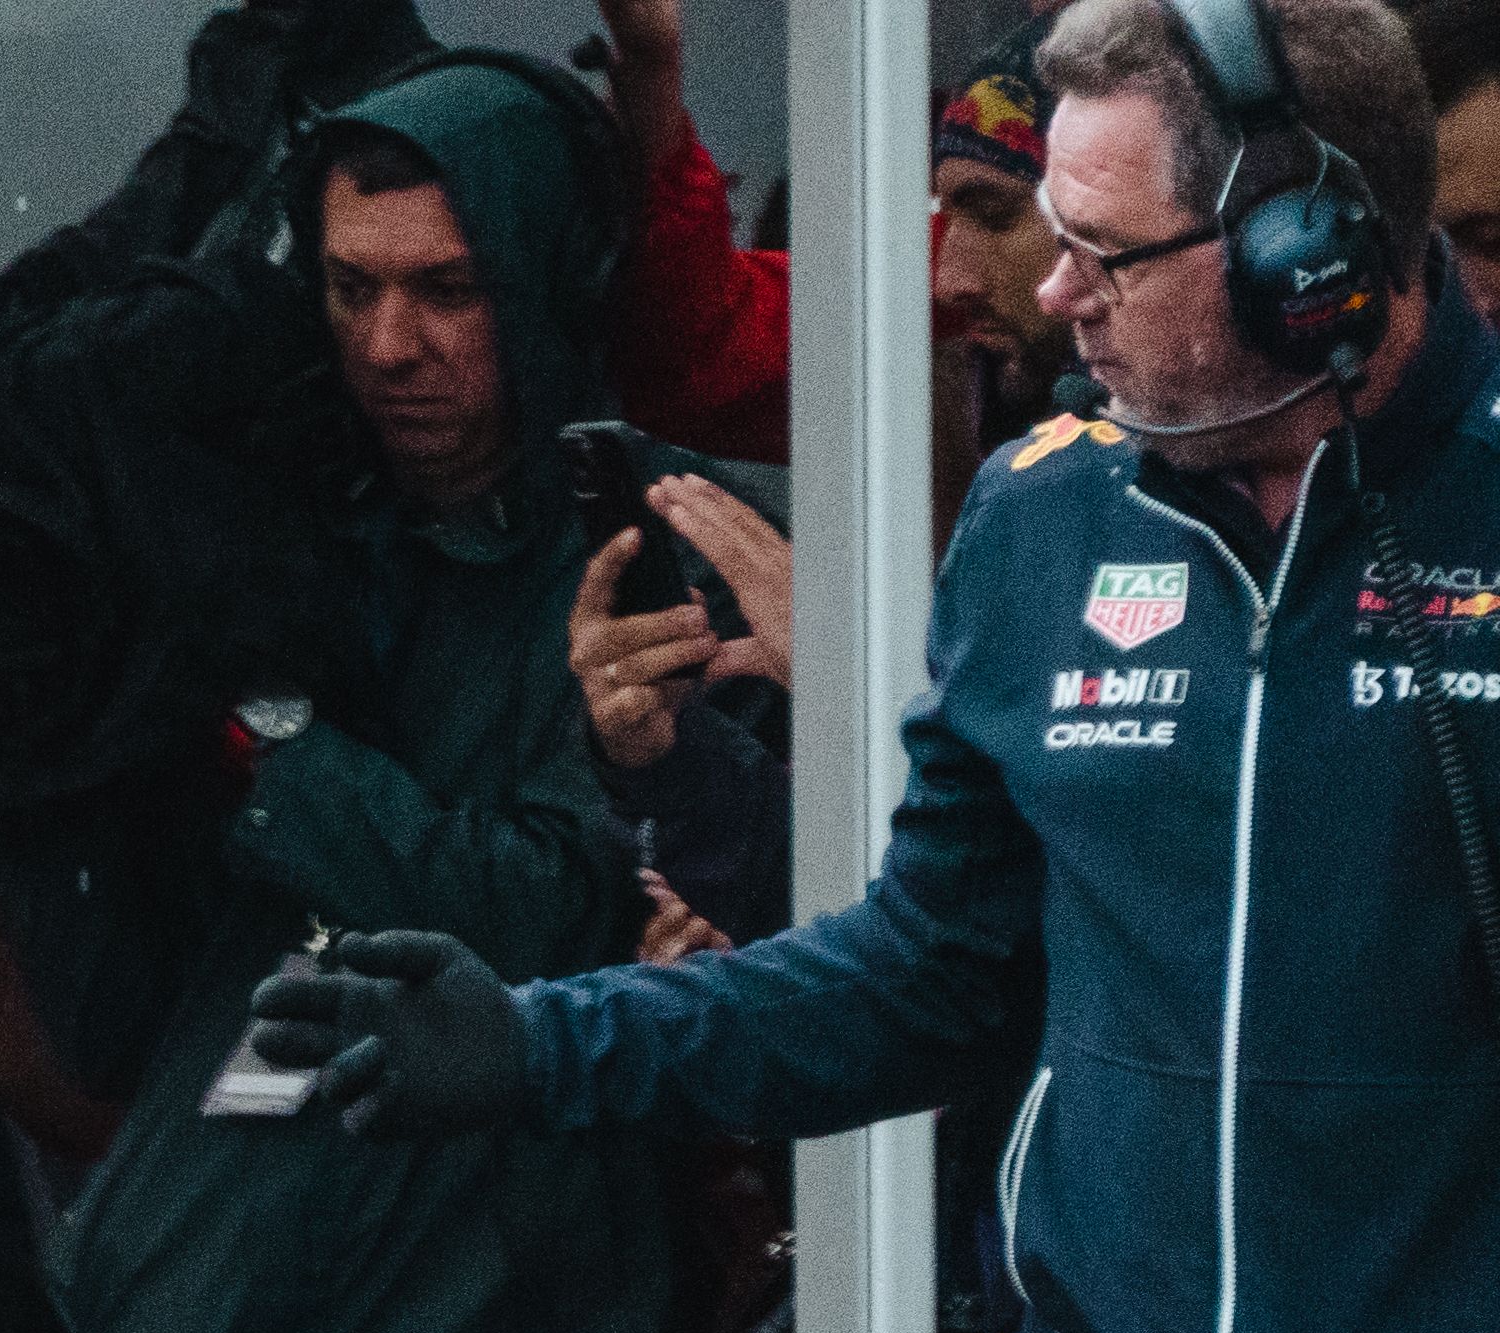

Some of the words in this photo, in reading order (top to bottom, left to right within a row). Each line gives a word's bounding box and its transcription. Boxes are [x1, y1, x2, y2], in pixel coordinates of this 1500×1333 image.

[1106, 571, 1180, 597] TAG
[1089, 601, 1184, 638] HEUER
[1051, 668, 1150, 711] Mobil
[1045, 720, 1178, 751] ORACLE
